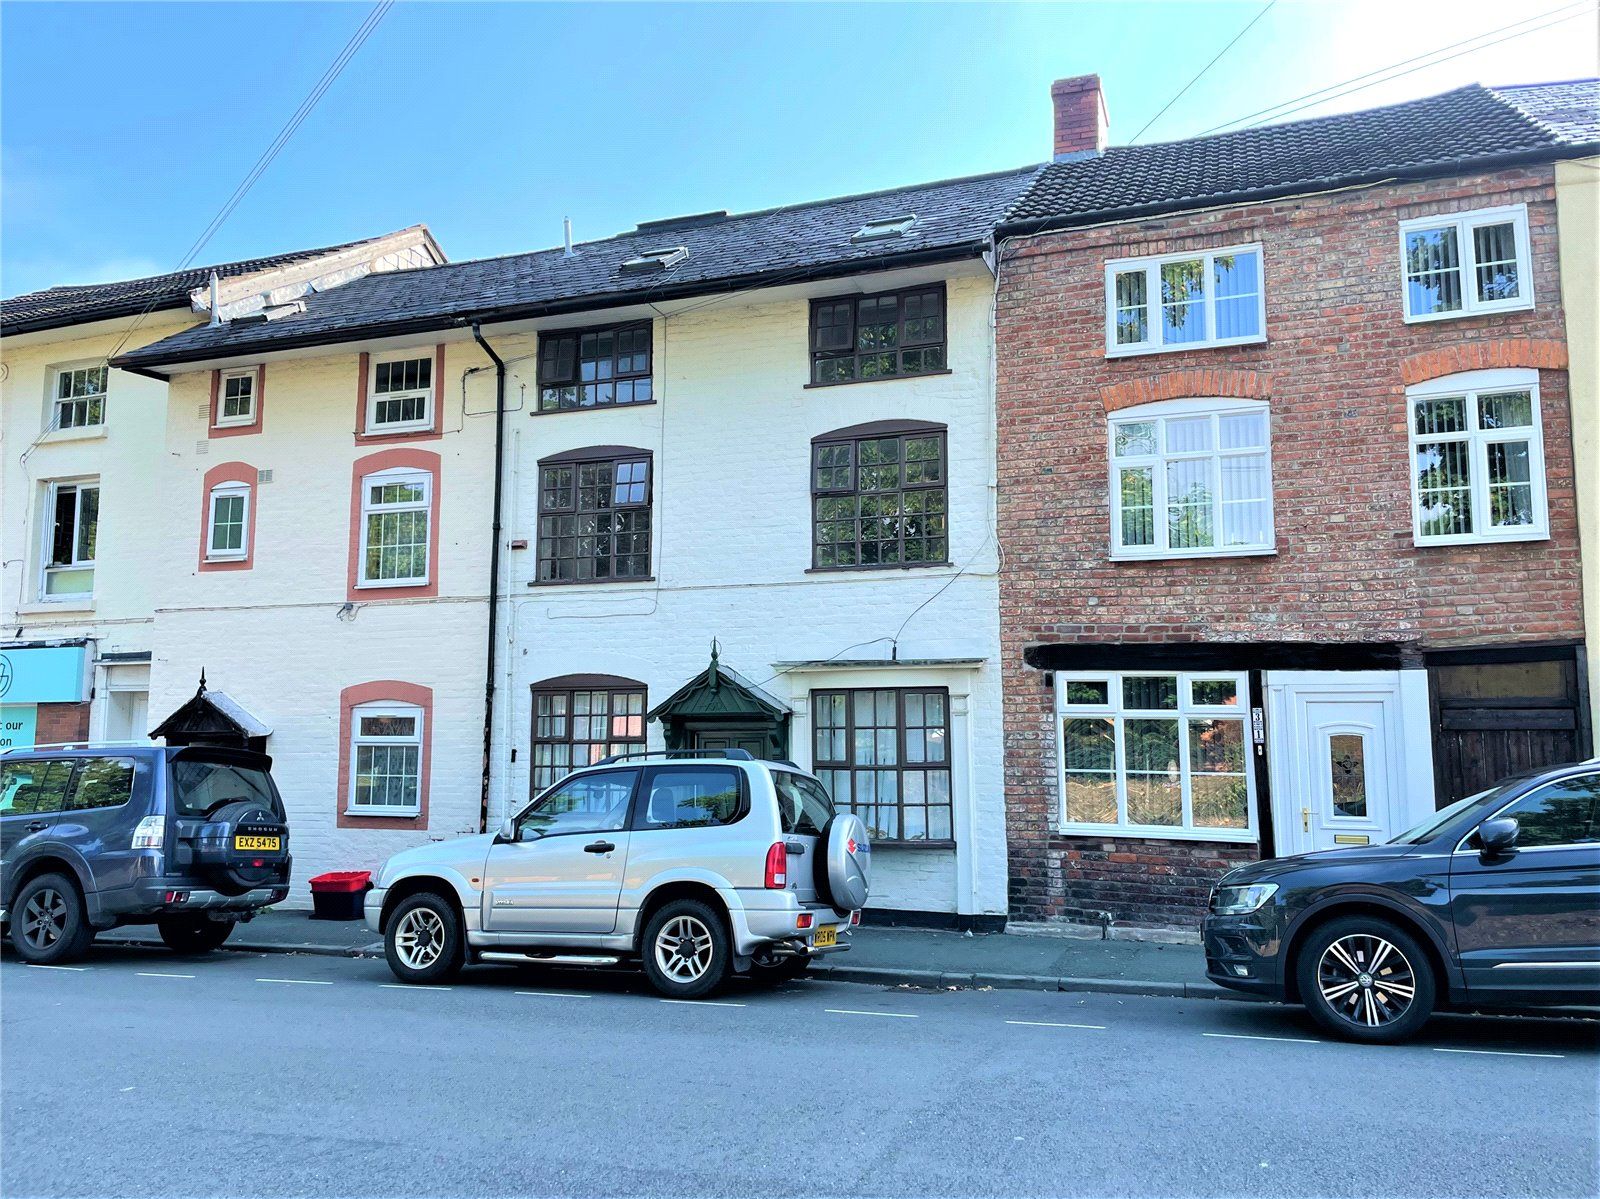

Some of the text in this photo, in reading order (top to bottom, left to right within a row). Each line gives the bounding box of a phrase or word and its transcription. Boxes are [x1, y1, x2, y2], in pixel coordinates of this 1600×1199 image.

[5, 721, 24, 731] our
[239, 837, 277, 848] EXZ 5475
